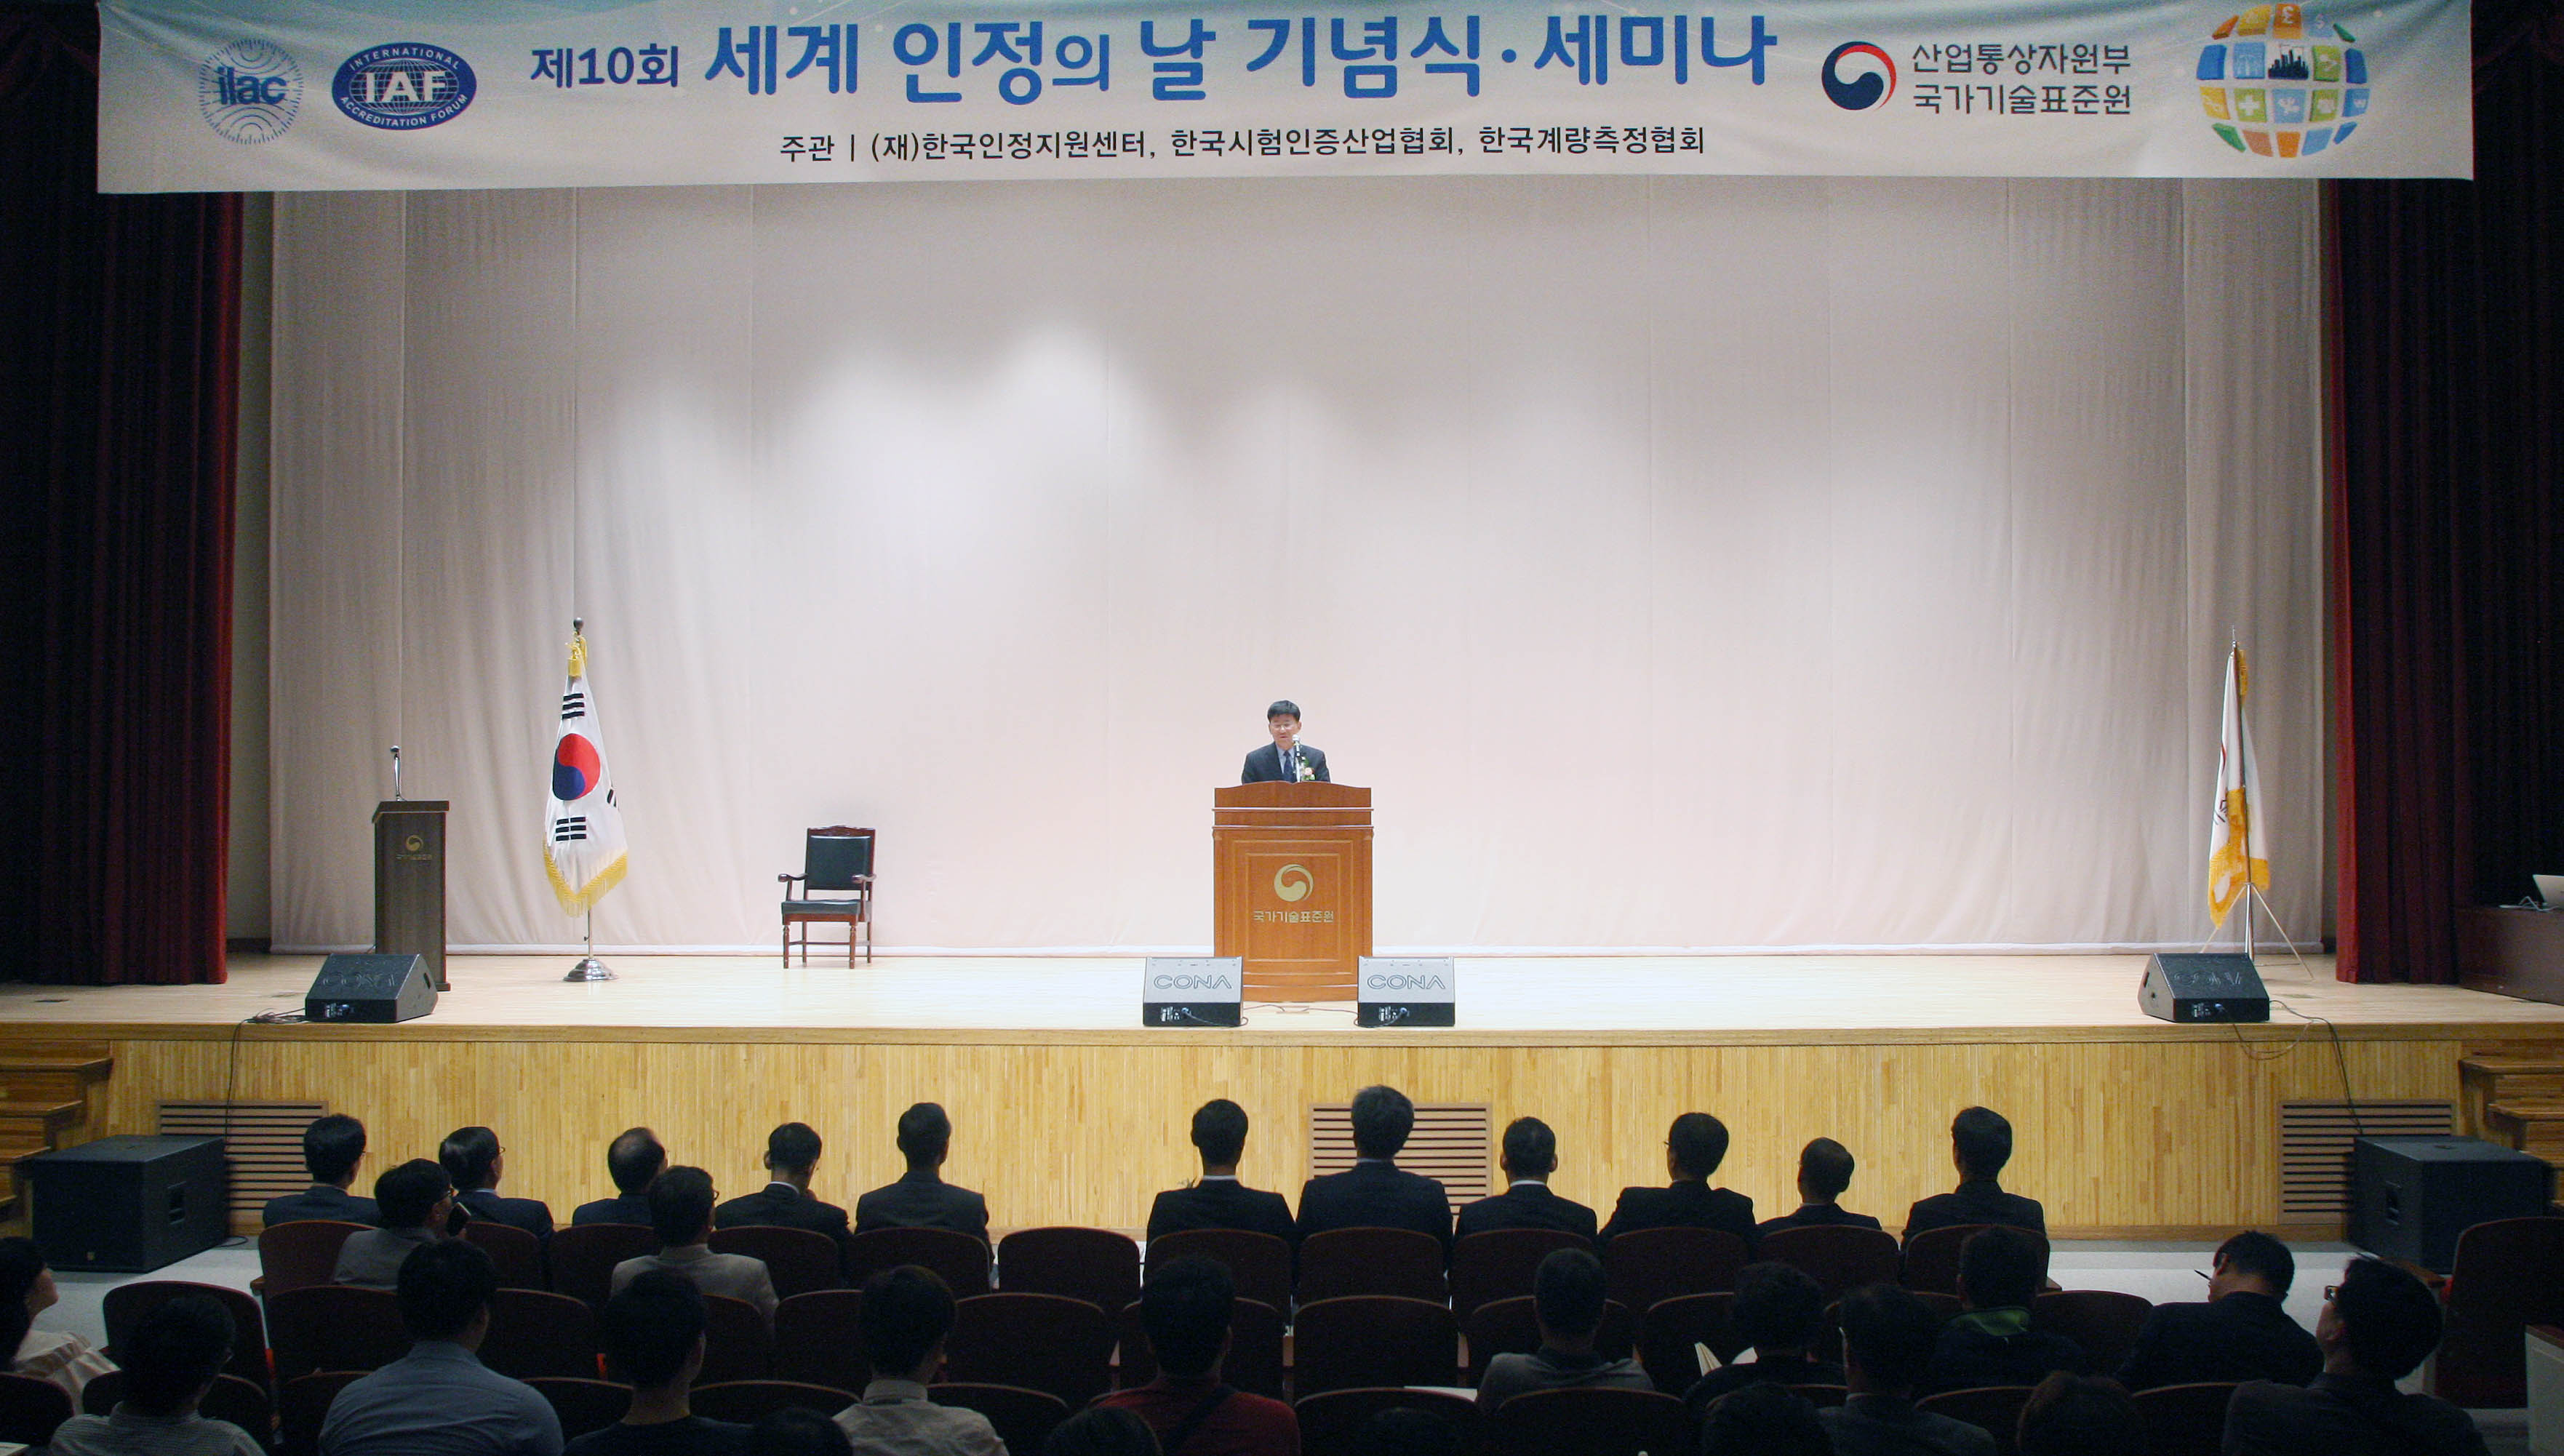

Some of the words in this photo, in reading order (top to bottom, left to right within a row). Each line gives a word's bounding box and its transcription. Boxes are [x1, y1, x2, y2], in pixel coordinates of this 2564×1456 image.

[349, 47, 460, 71] INTERNATIONAL
[530, 44, 679, 88] 제10회
[705, 23, 858, 95] 세계
[893, 21, 1109, 105] 인정의
[1141, 19, 1216, 100] 날
[1912, 44, 2130, 74] 산업통상자원부
[217, 66, 287, 105] ilac
[365, 71, 447, 102] IAF
[1913, 84, 2131, 115] 국가기술표준원
[340, 96, 427, 127] ACCREDITATION
[431, 93, 468, 121] FORUM
[780, 135, 834, 161] 주관
[871, 131, 1156, 161] (재)한국인정지원센터,
[1170, 127, 1463, 157] 한국시험인증산업협회,
[1479, 126, 1705, 155] 한국계량측정협회
[1253, 910, 1335, 924] 국가기술표준원
[1154, 974, 1232, 990] CONA
[1367, 974, 1445, 990] CONA
